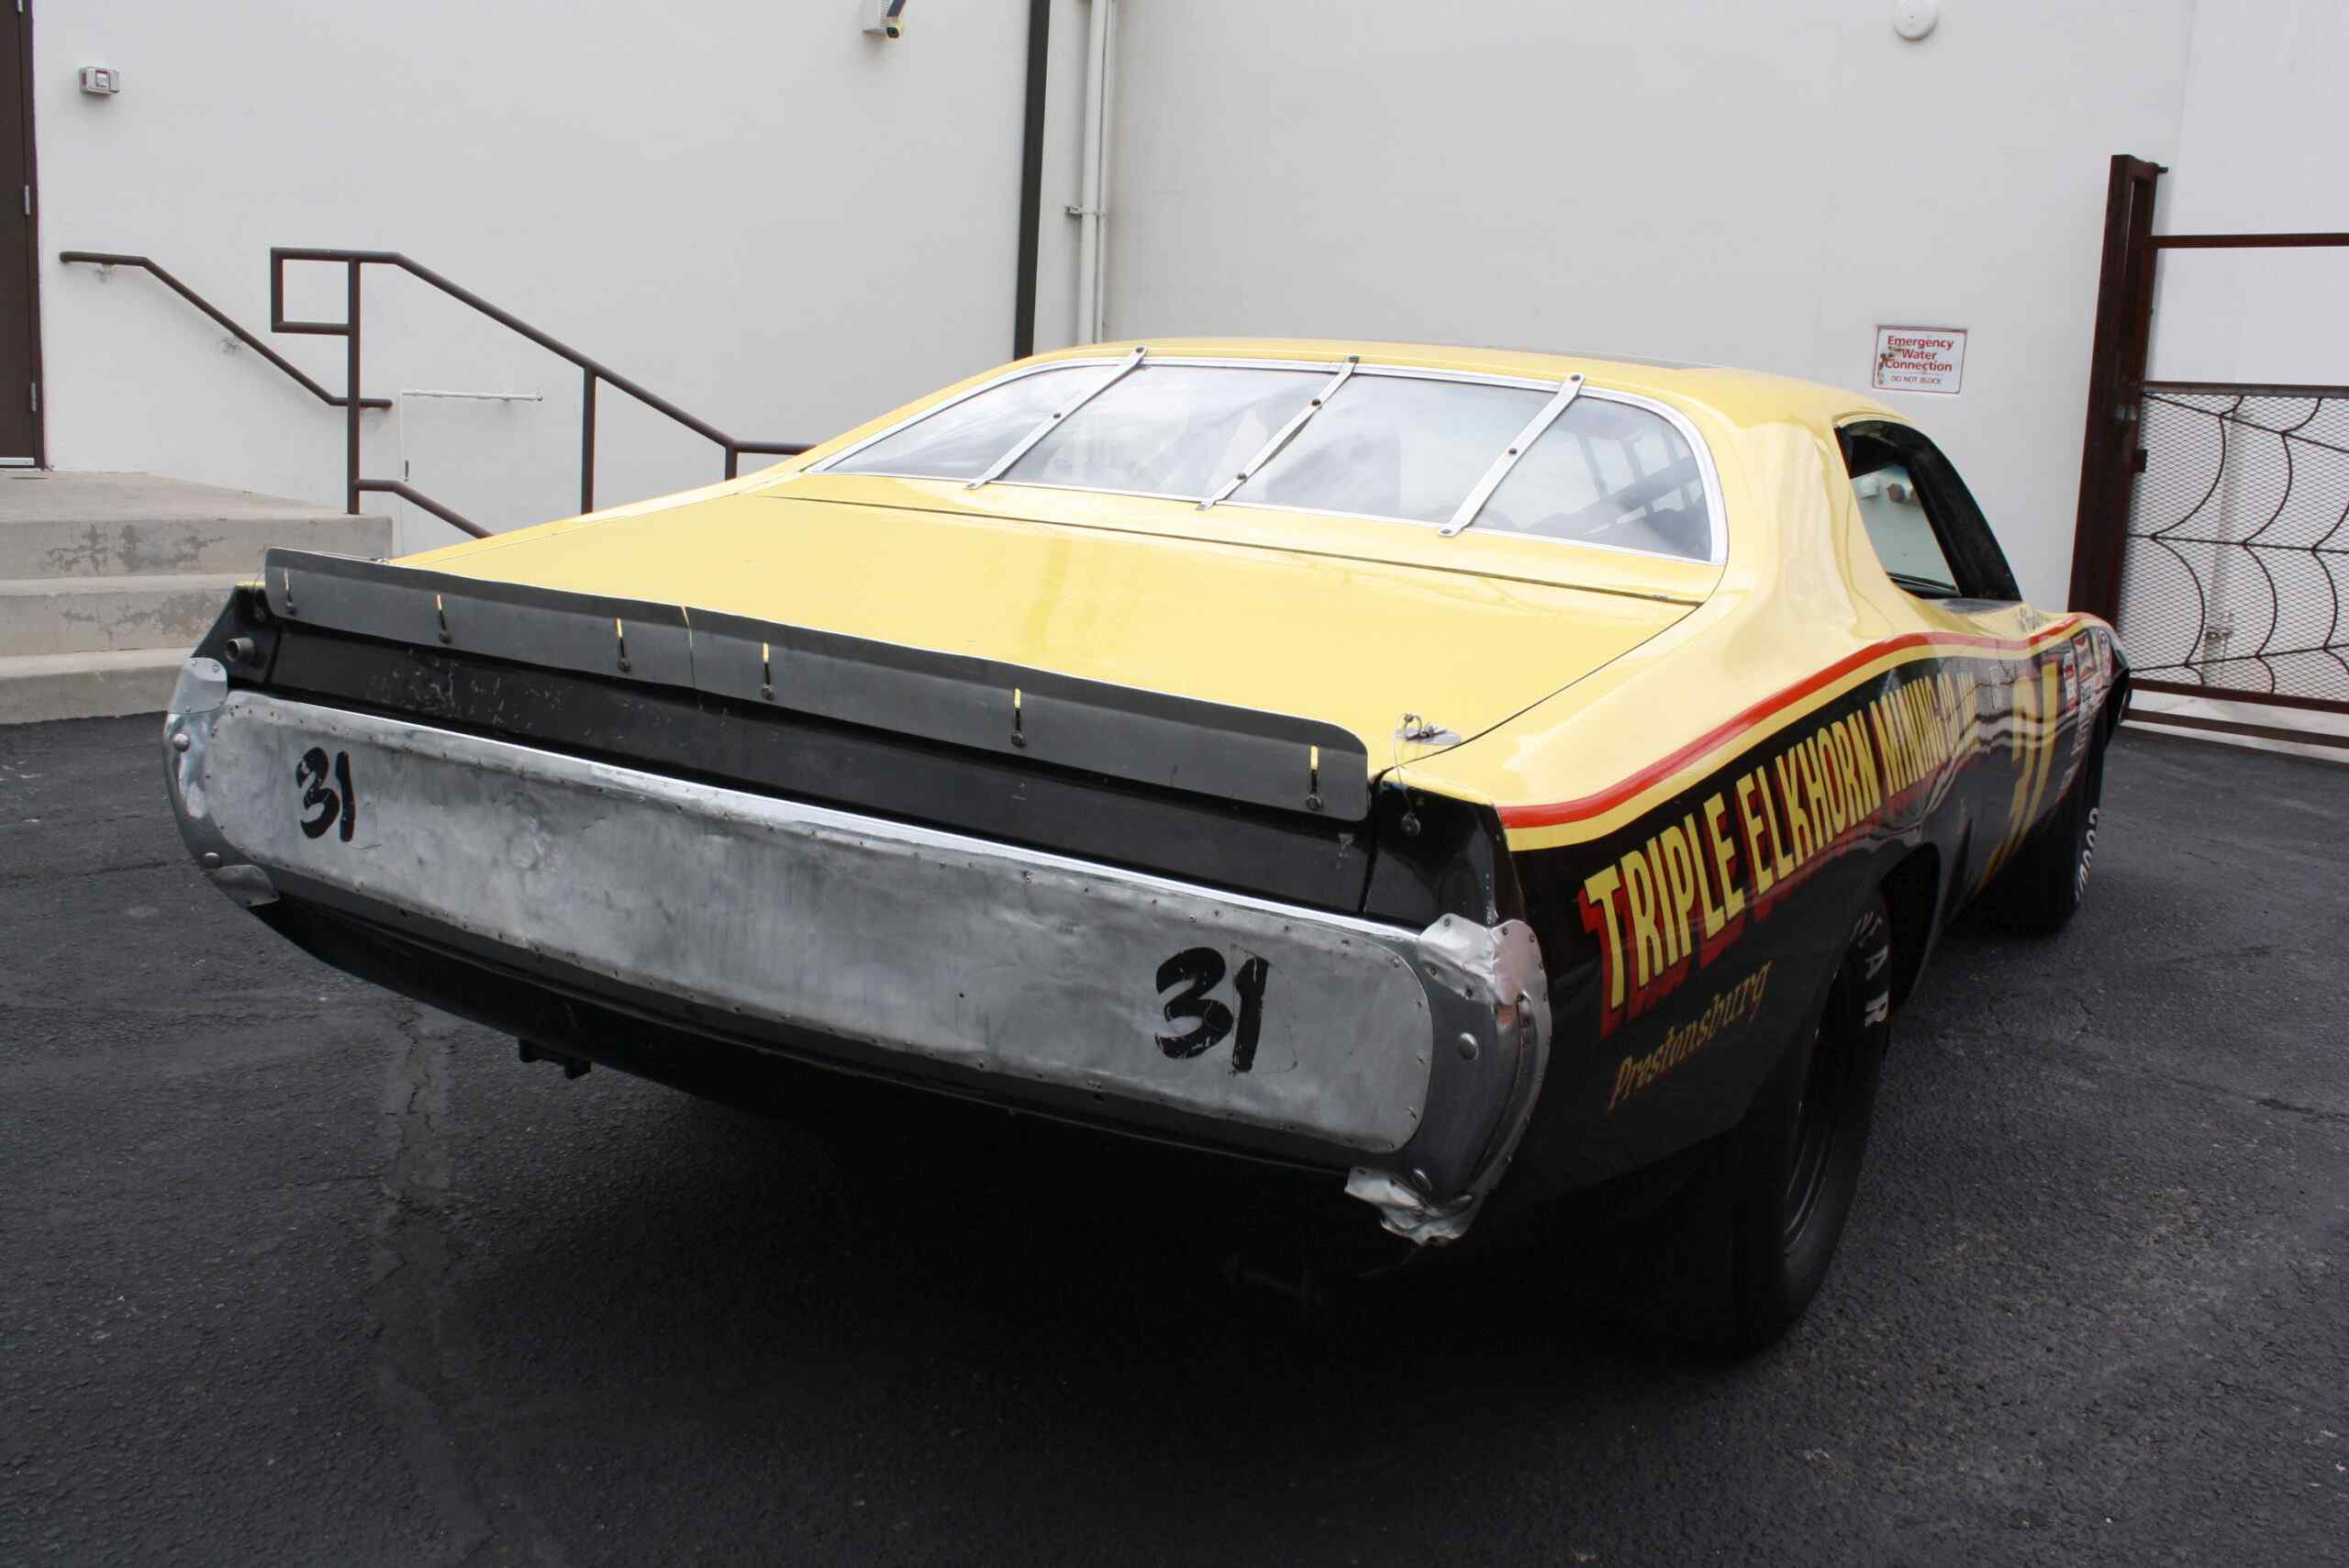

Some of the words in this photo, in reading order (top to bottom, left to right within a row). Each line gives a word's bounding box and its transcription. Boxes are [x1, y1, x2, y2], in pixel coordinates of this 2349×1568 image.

[1885, 360, 1953, 372] Connection
[1887, 336, 1954, 350] Emergency
[1901, 349, 1938, 360] Water
[295, 747, 356, 842] 31
[1584, 792, 1744, 1009] TRIPLE
[1736, 709, 1881, 895] ELKHORN
[1154, 947, 1269, 1075] 31
